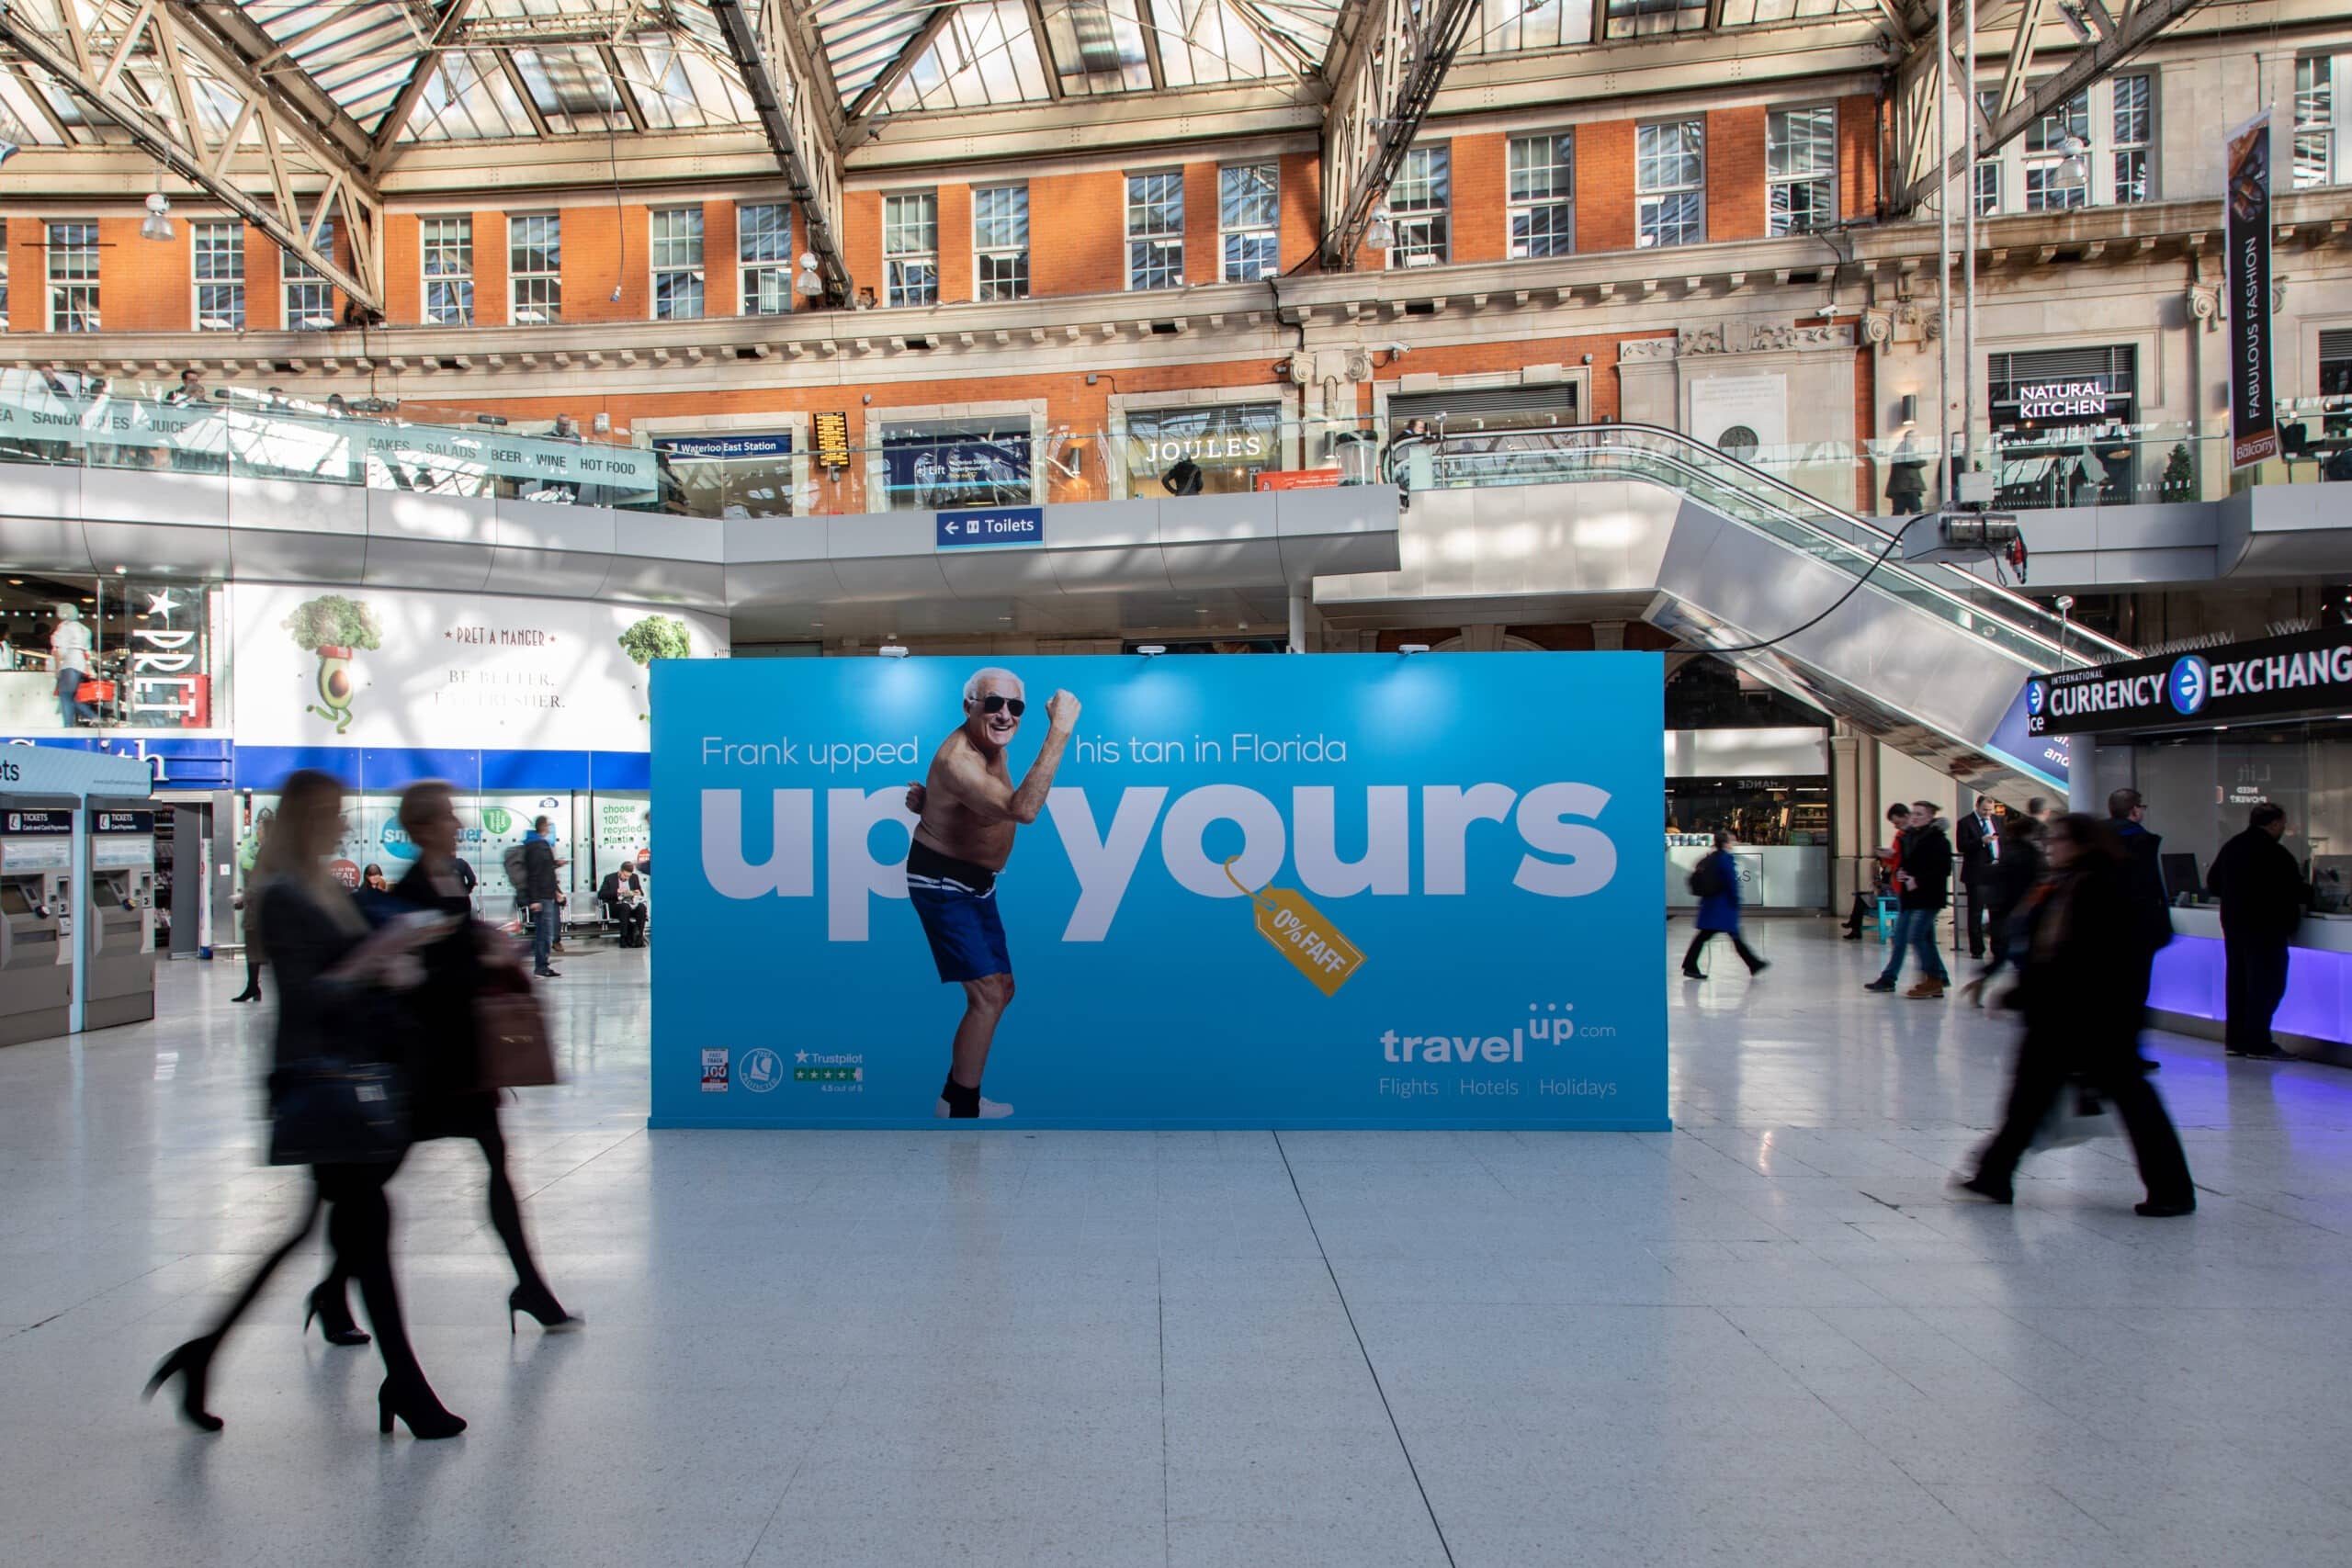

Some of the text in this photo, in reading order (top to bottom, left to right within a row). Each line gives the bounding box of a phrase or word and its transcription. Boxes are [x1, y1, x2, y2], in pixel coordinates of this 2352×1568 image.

[2245, 236, 2260, 419] FABULOUS FASHION
[2020, 381, 2105, 400] NATURAL
[2020, 399, 2106, 418] KITCHEN
[368, 437, 636, 475] CAKES SALADS BEER WINE HOT FOOD
[681, 441, 776, 454] Waterloo East Station
[1146, 436, 1261, 462] JOULES
[2236, 440, 2274, 460] Balcony
[985, 518, 1034, 534] Toilets
[457, 627, 545, 646] PRET A MANGER
[133, 630, 197, 717] PRET
[2051, 669, 2104, 686] INTERNATIONAL
[2050, 672, 2166, 716] CURRENCY
[2027, 714, 2044, 731] ice
[702, 733, 1347, 773] Frank upped his tan in Florida
[604, 805, 635, 814] choose
[604, 825, 642, 835] recycled
[701, 782, 1617, 942] up yours
[1273, 908, 1347, 974] 0% FAFF
[812, 1053, 863, 1066] Trustpilot
[703, 1066, 727, 1078] 100
[833, 1084, 845, 1092] out
[847, 1084, 855, 1092] of
[1380, 1077, 1617, 1099] Flights Hotels Holidays
